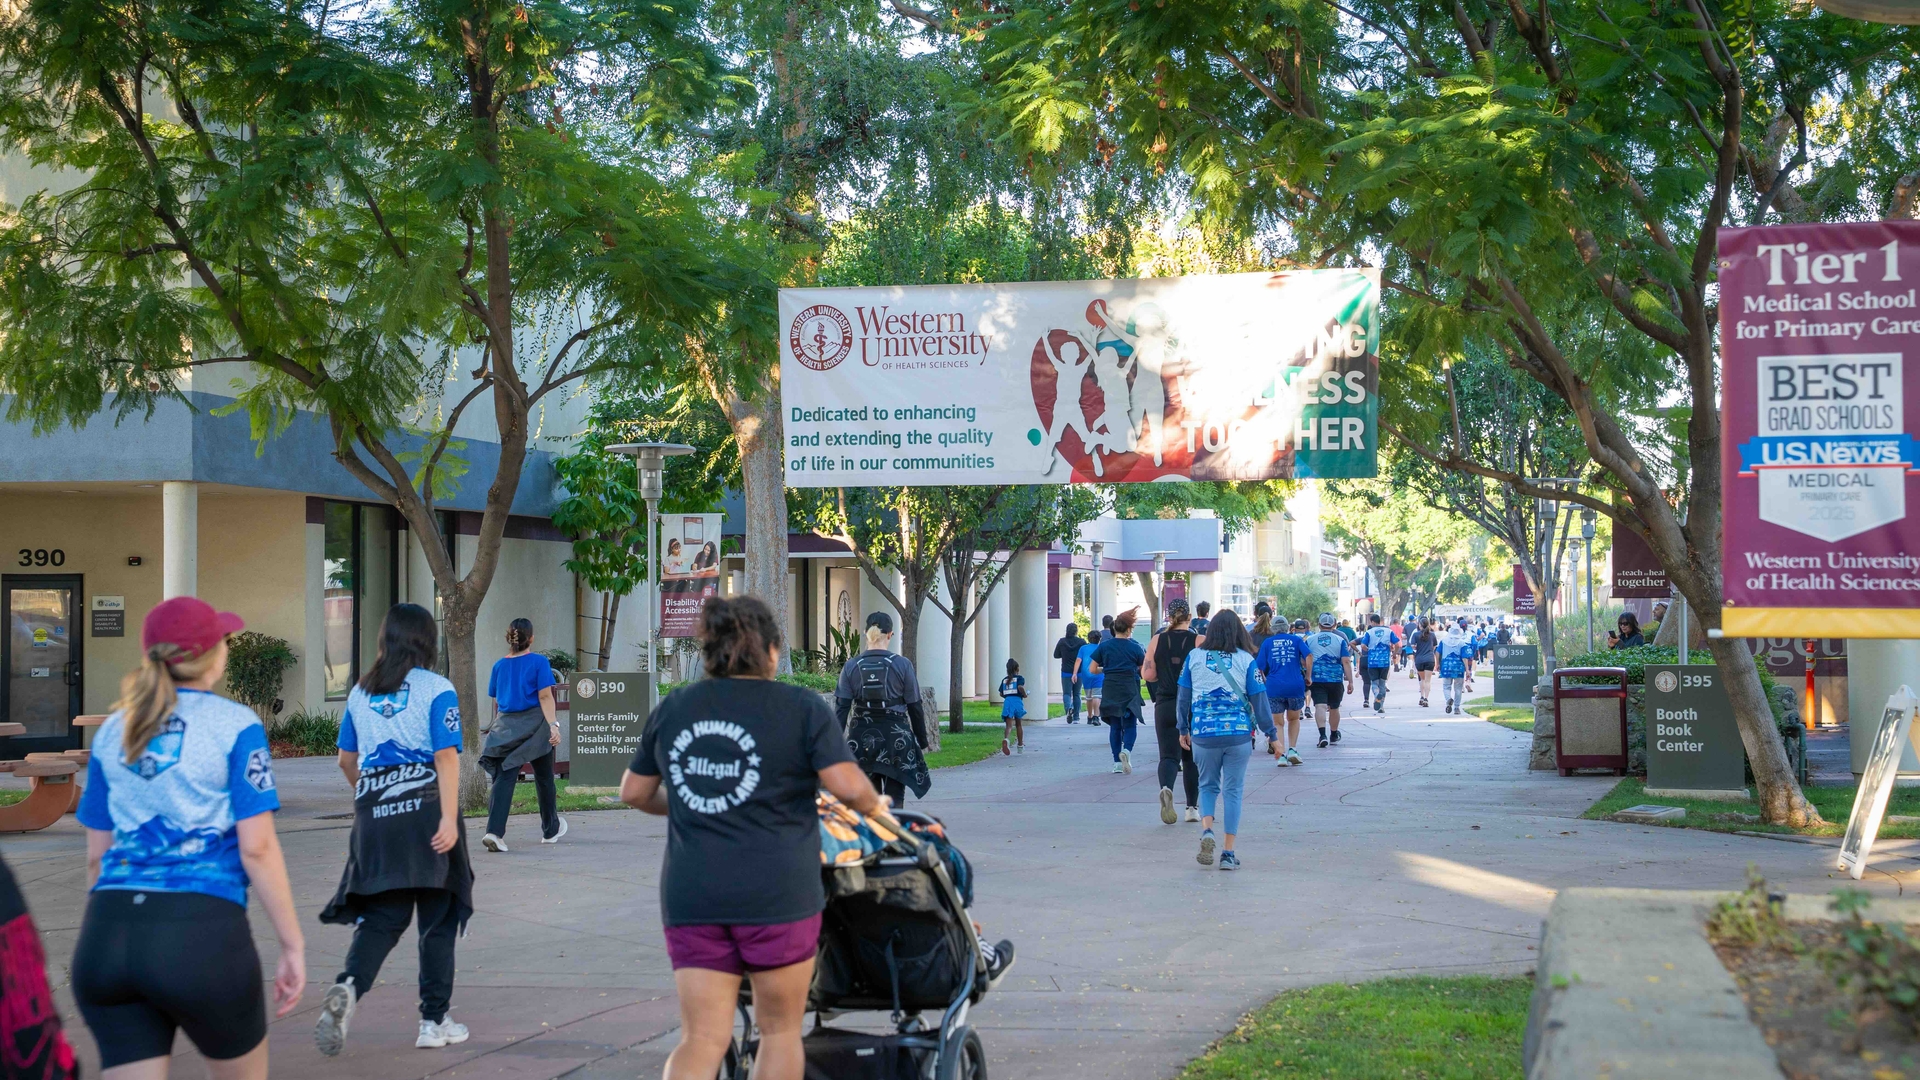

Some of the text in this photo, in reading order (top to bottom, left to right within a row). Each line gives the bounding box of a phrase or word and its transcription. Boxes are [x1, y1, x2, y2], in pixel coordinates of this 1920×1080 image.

[1757, 239, 1902, 285] Tier 1
[1743, 289, 1916, 313] Medical School
[791, 307, 816, 339] WESTERN
[818, 306, 852, 337] UNIVERSITY
[855, 306, 966, 335] Western
[1735, 317, 1920, 340] for Primary Care
[793, 345, 850, 370] OF HEALTH SCIENCES
[859, 331, 993, 366] University
[882, 360, 969, 370] OF HEALTH SCIENCES
[1768, 363, 1892, 402] BEST
[791, 404, 976, 423] Dedicated to enhancing
[1768, 404, 1894, 431] GRAD SCHOOLS
[790, 429, 993, 448] and extending the quality
[790, 454, 995, 471] of life in our communities
[1787, 472, 1875, 488] MEDICAL
[1800, 491, 1862, 501] PRIMARY CARE
[1808, 506, 1856, 521] 2025
[18, 549, 66, 567] 390
[1744, 552, 1920, 575] Western University
[1617, 577, 1666, 589] together
[1745, 572, 1920, 590] of Health Sciences
[665, 598, 699, 607] Disability
[600, 682, 625, 693] 390
[1683, 675, 1712, 687] 395
[577, 712, 639, 723] Harris Family
[1656, 708, 1698, 720] Booth
[577, 723, 626, 732] Center for
[673, 720, 756, 753] NO HUMAN IS
[1657, 723, 1692, 736] Book
[577, 734, 622, 745] Disability
[1657, 739, 1704, 752] Center
[577, 745, 608, 754] Health
[684, 755, 741, 780] Illegal
[354, 763, 430, 800] Ducks
[669, 763, 761, 814] ON STOLEN LAND
[373, 798, 422, 818] HOCKEY
